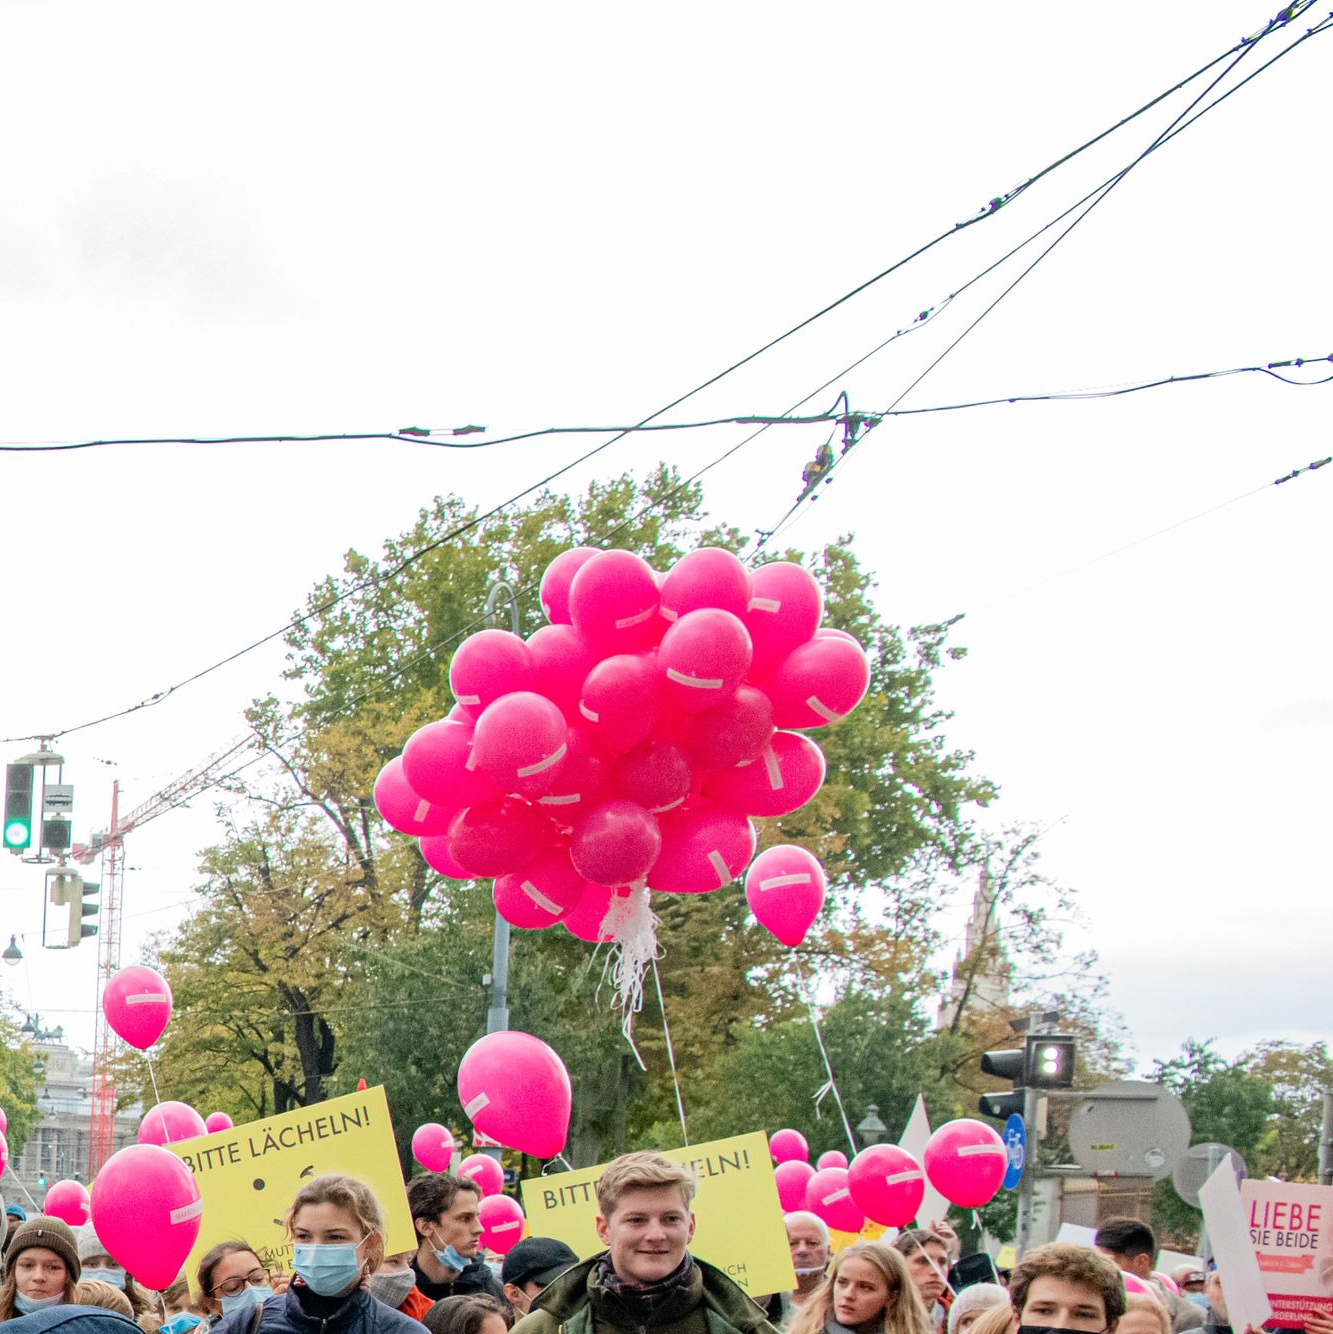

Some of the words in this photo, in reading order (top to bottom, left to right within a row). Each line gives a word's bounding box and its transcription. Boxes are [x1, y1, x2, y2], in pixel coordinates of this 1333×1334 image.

[248, 1105, 371, 1159] LÄCHELN!
[543, 1181, 599, 1210] BITT
[1249, 1199, 1322, 1233] LIEBE
[1249, 1229, 1271, 1247] SIE
[1275, 1231, 1320, 1250] BEIDE
[1269, 1299, 1333, 1314] NTERSTÜTZUNG
